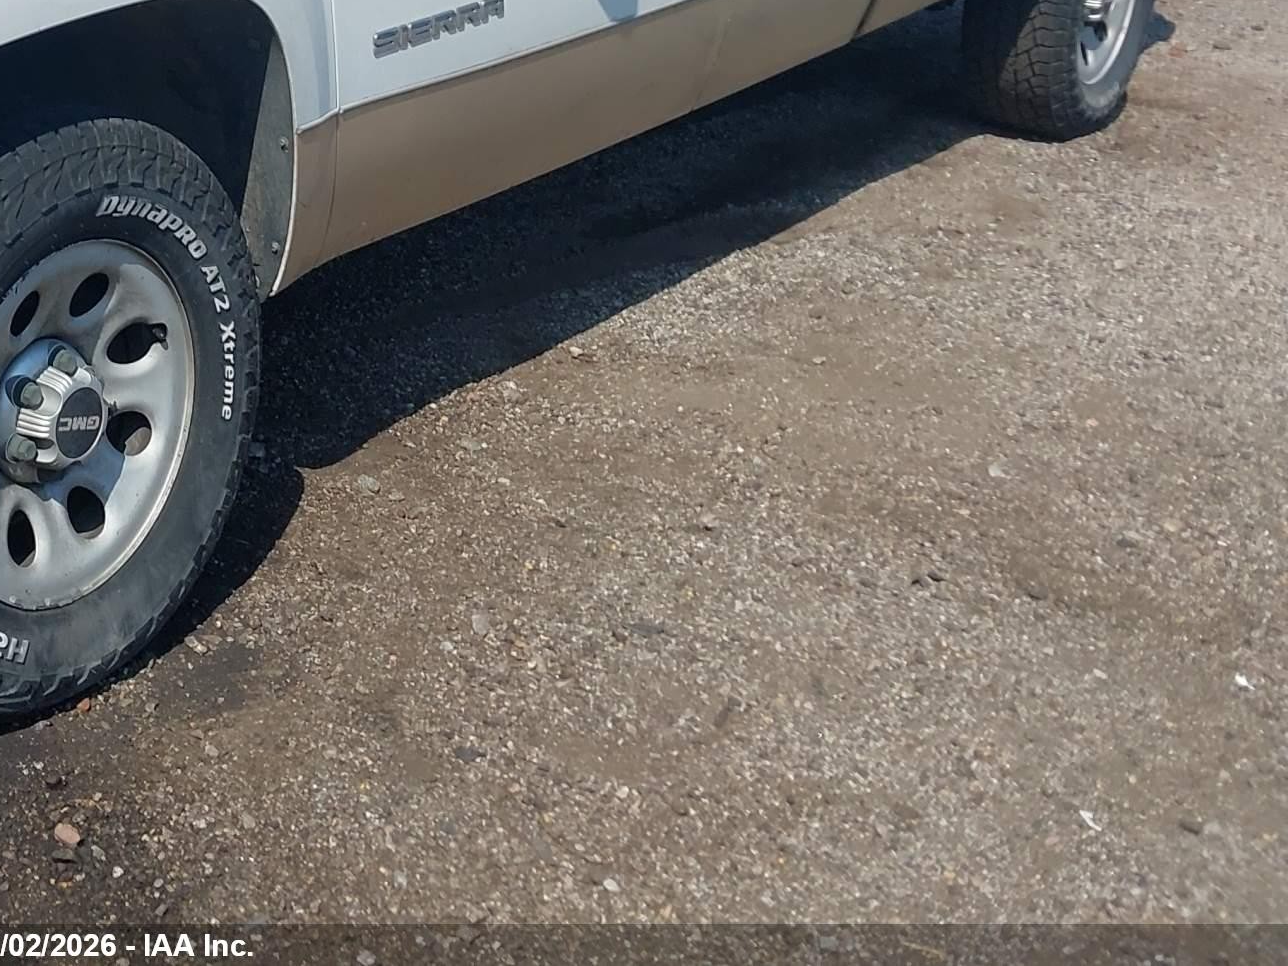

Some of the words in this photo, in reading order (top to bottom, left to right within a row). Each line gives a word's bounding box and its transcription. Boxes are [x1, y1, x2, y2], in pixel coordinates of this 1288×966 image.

[201, 265, 231, 313] AT2
[218, 322, 237, 421] Xtreme
[58, 415, 100, 432] GMC
